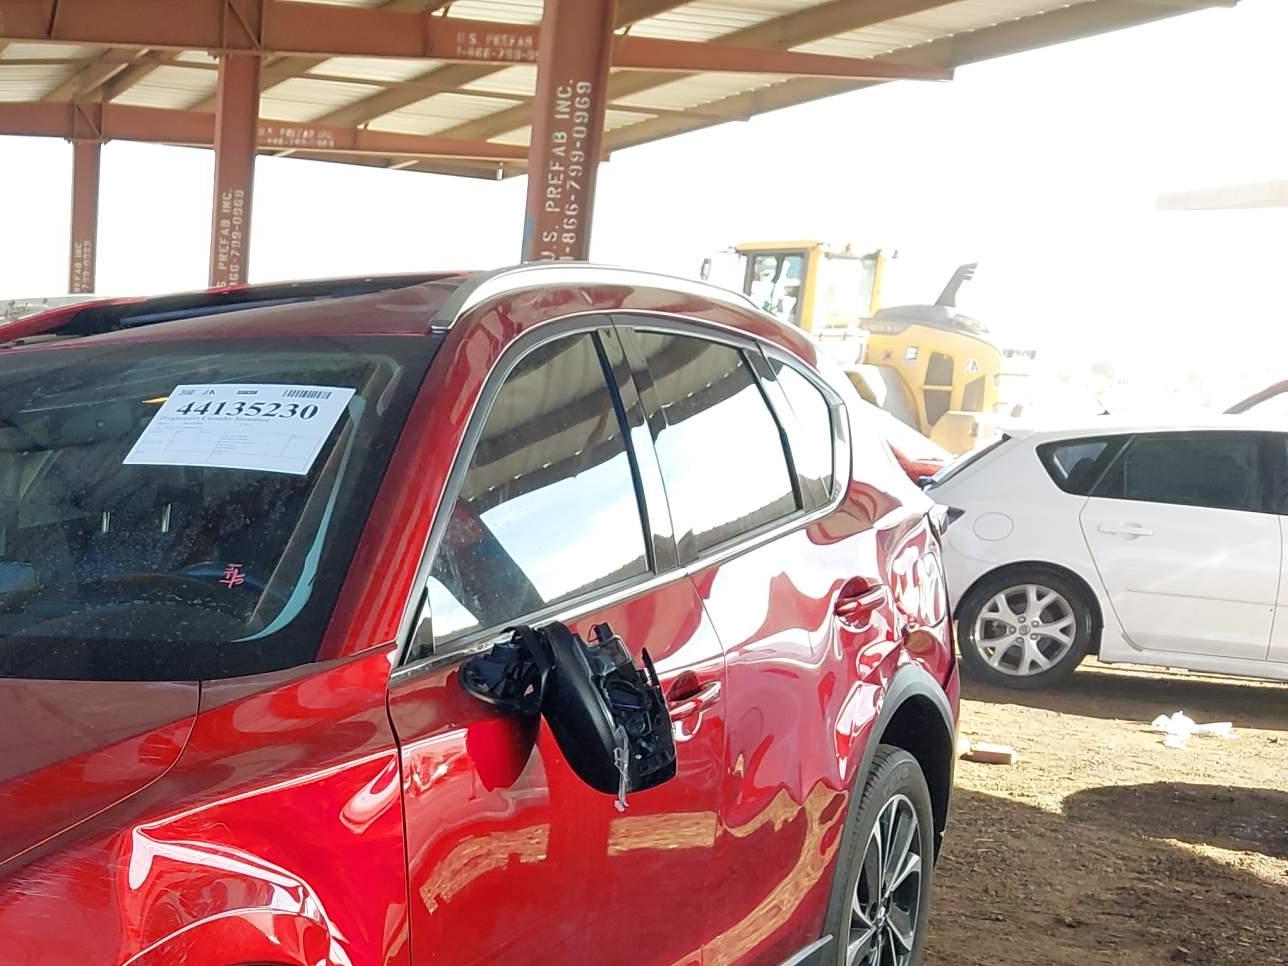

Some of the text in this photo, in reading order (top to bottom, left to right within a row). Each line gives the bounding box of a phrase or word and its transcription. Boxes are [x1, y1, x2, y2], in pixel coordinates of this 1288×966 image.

[553, 79, 574, 120] INC.
[545, 131, 568, 212] PREFAB
[217, 219, 232, 270] PREFAB
[176, 401, 319, 420] 44135230
